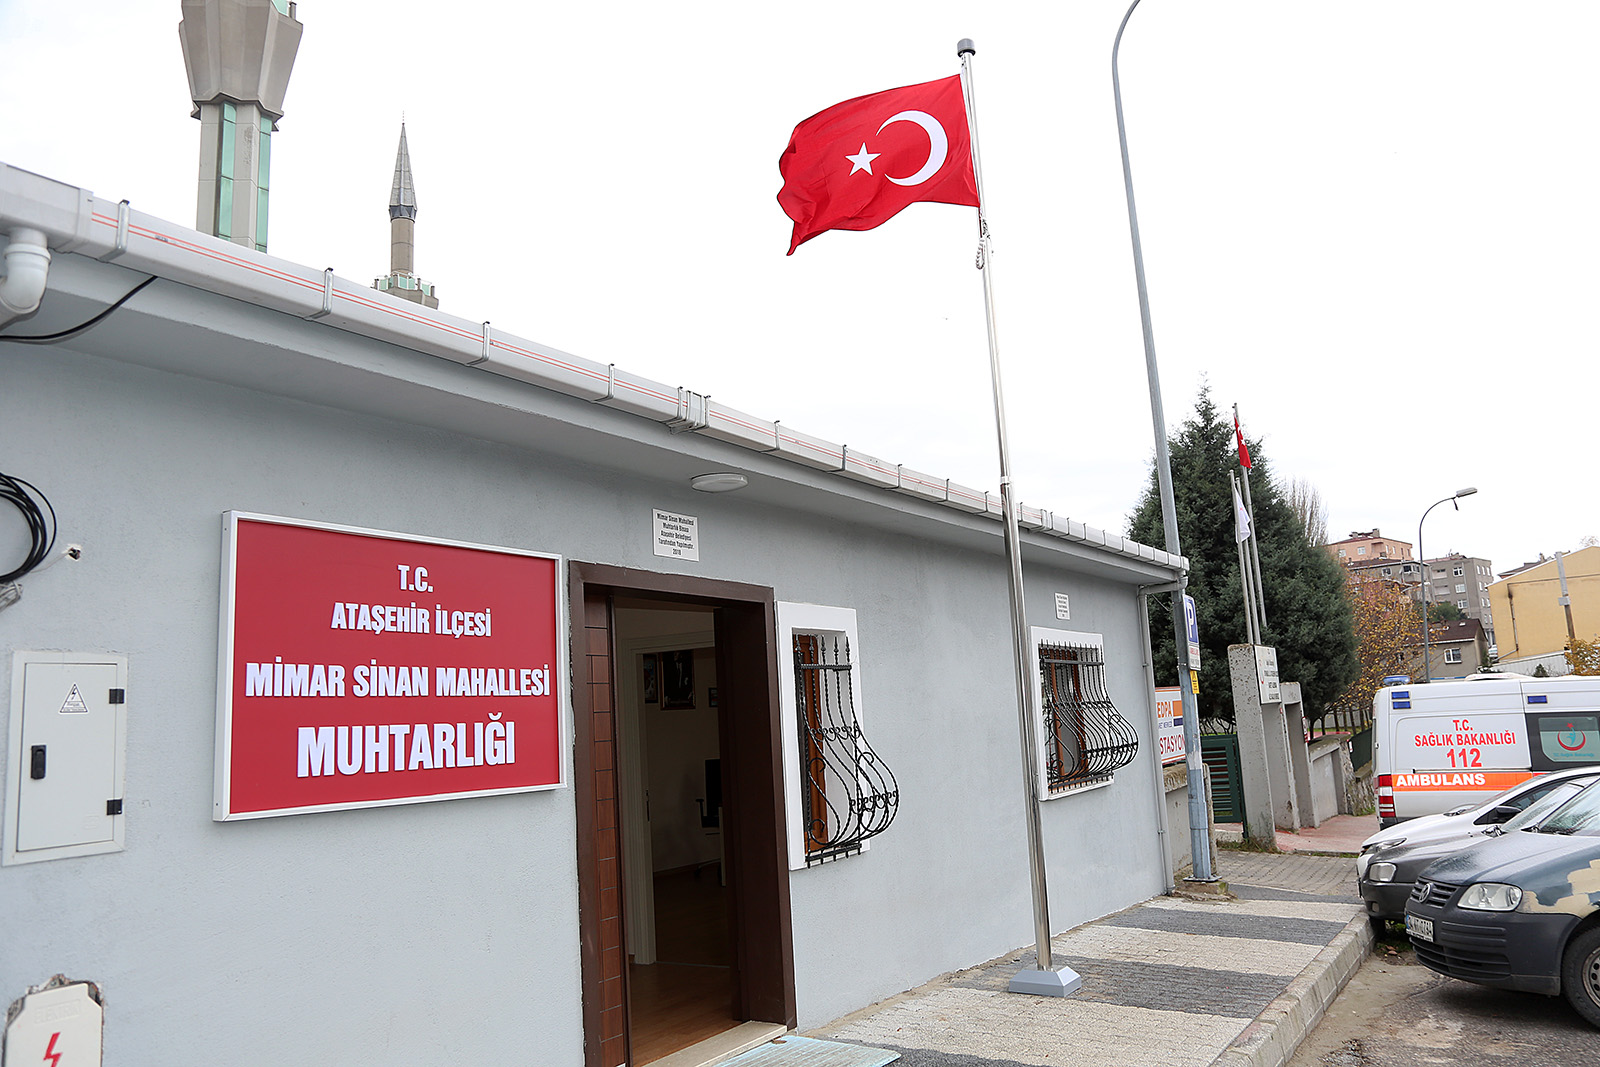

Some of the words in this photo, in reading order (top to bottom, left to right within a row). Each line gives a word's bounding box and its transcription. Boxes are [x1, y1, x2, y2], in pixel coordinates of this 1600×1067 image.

[397, 564, 434, 592] T.C.
[330, 601, 430, 635] ATAŞEHİR
[435, 603, 492, 639] İLÇESİ
[245, 656, 346, 697] MİMAR
[352, 658, 429, 697] SİNAN
[435, 663, 551, 697] MAHALLESİ
[1452, 719, 1474, 731] T.C.
[297, 712, 516, 778] MUHTARLIĞI
[1414, 732, 1454, 747] SAĞLIK
[1456, 729, 1516, 746] BAKANLIĞI
[1446, 747, 1482, 768] 112
[1396, 773, 1486, 786] AMBULANS
